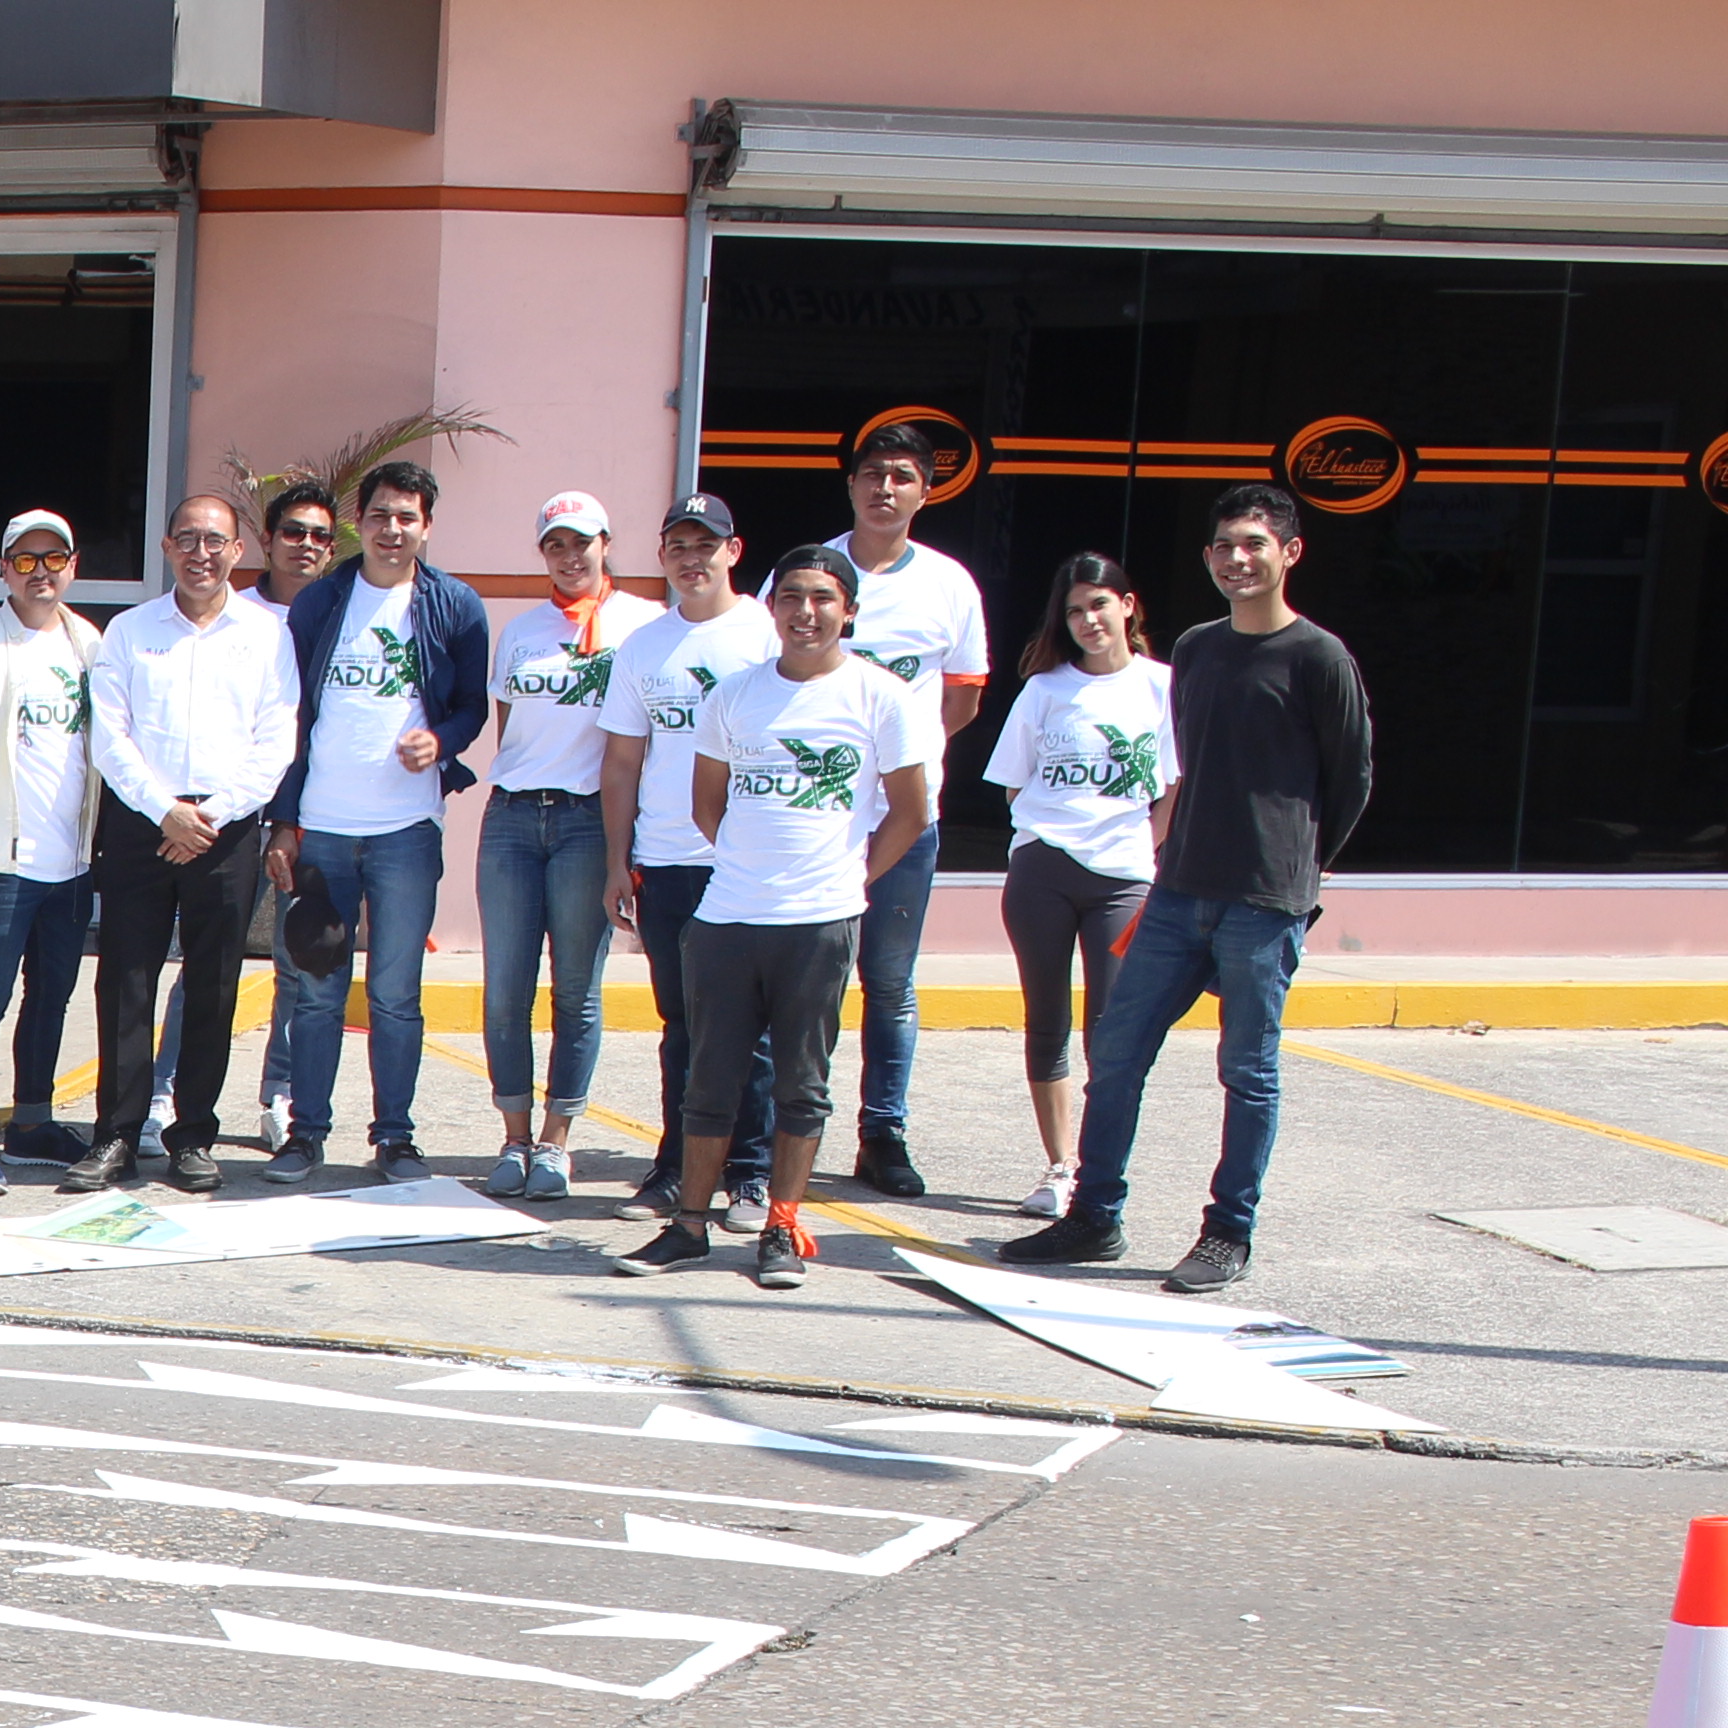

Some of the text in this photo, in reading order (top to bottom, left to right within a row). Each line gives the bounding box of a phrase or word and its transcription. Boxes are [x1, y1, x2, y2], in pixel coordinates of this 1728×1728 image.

[384, 647, 404, 660] SIGA
[17, 704, 69, 725] ADU
[1109, 746, 1131, 758] SIGA
[797, 760, 821, 769] SIGA
[1042, 763, 1113, 788] FADU
[733, 773, 802, 797] FADU
